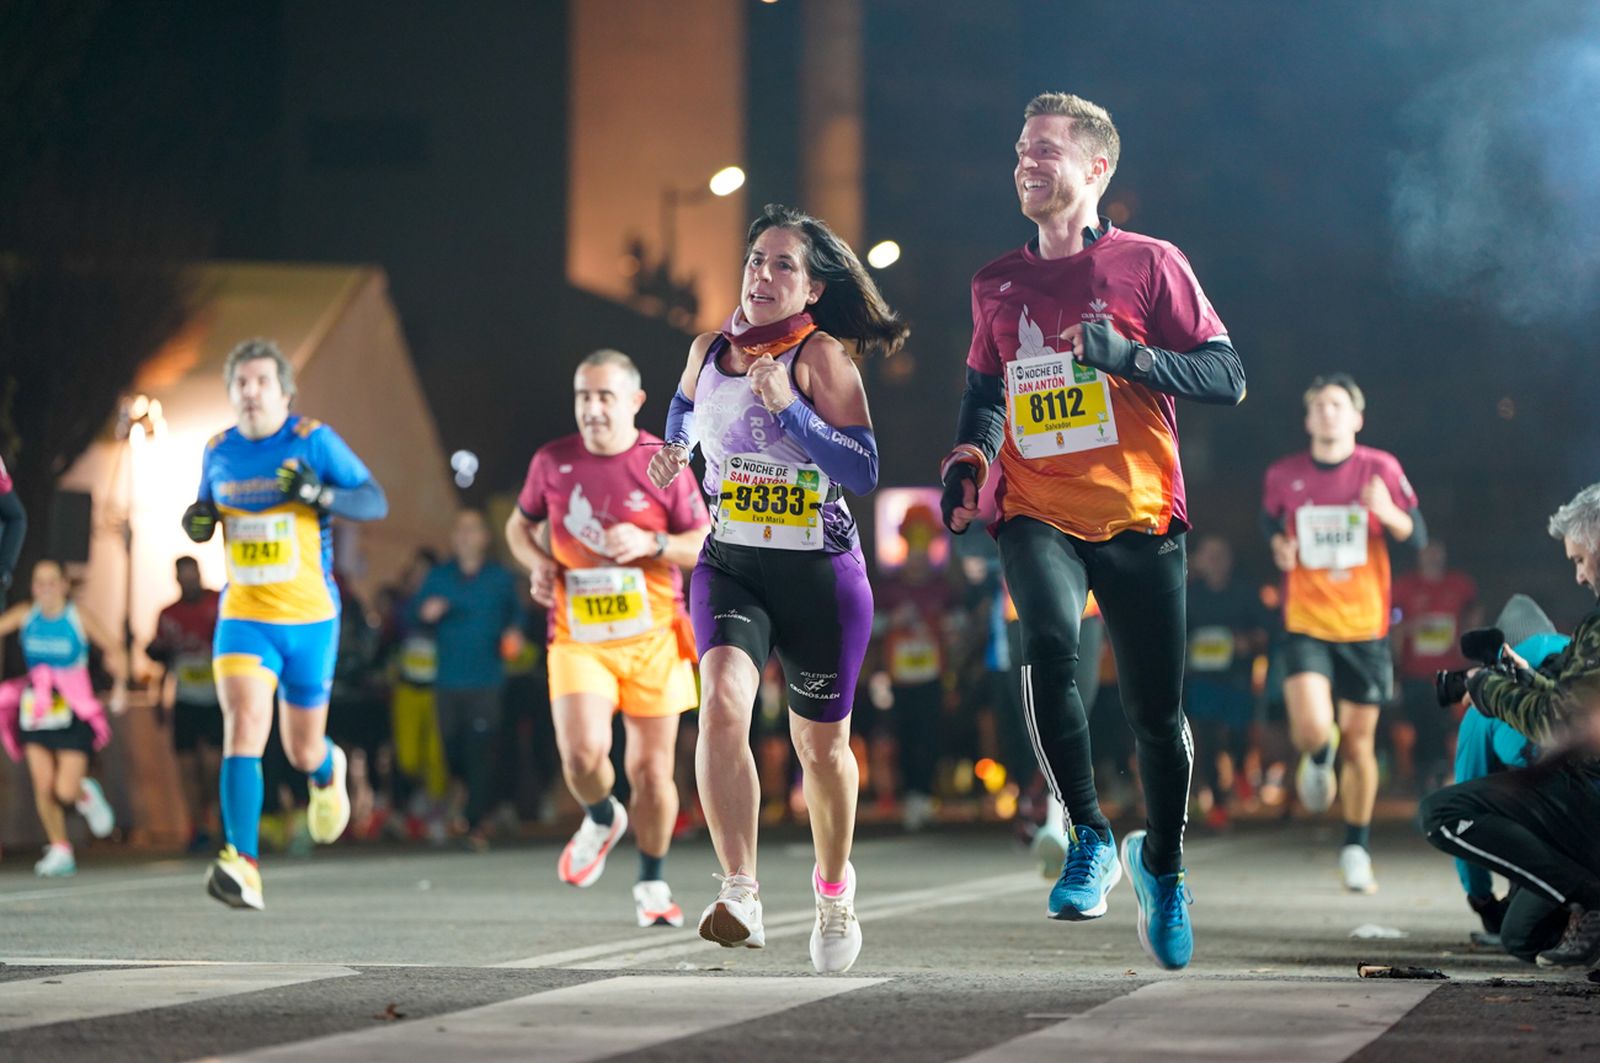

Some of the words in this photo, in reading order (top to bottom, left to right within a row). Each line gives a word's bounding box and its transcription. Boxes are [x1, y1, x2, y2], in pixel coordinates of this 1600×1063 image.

[1025, 366, 1051, 380] NOCHE
[1053, 364, 1063, 375] DE
[1018, 380, 1033, 394] SAN
[1035, 375, 1065, 392] ANTÓN
[1029, 387, 1086, 423] 8112
[1044, 422, 1072, 432] Salvador
[730, 471, 750, 484] SAN
[742, 462, 774, 476] NOCHE
[775, 467, 789, 477] DE
[735, 485, 805, 516] 9333
[752, 514, 764, 523] Eva
[241, 541, 280, 560] 7247
[585, 595, 629, 617] 1128
[800, 671, 838, 680] ATLETISMO
